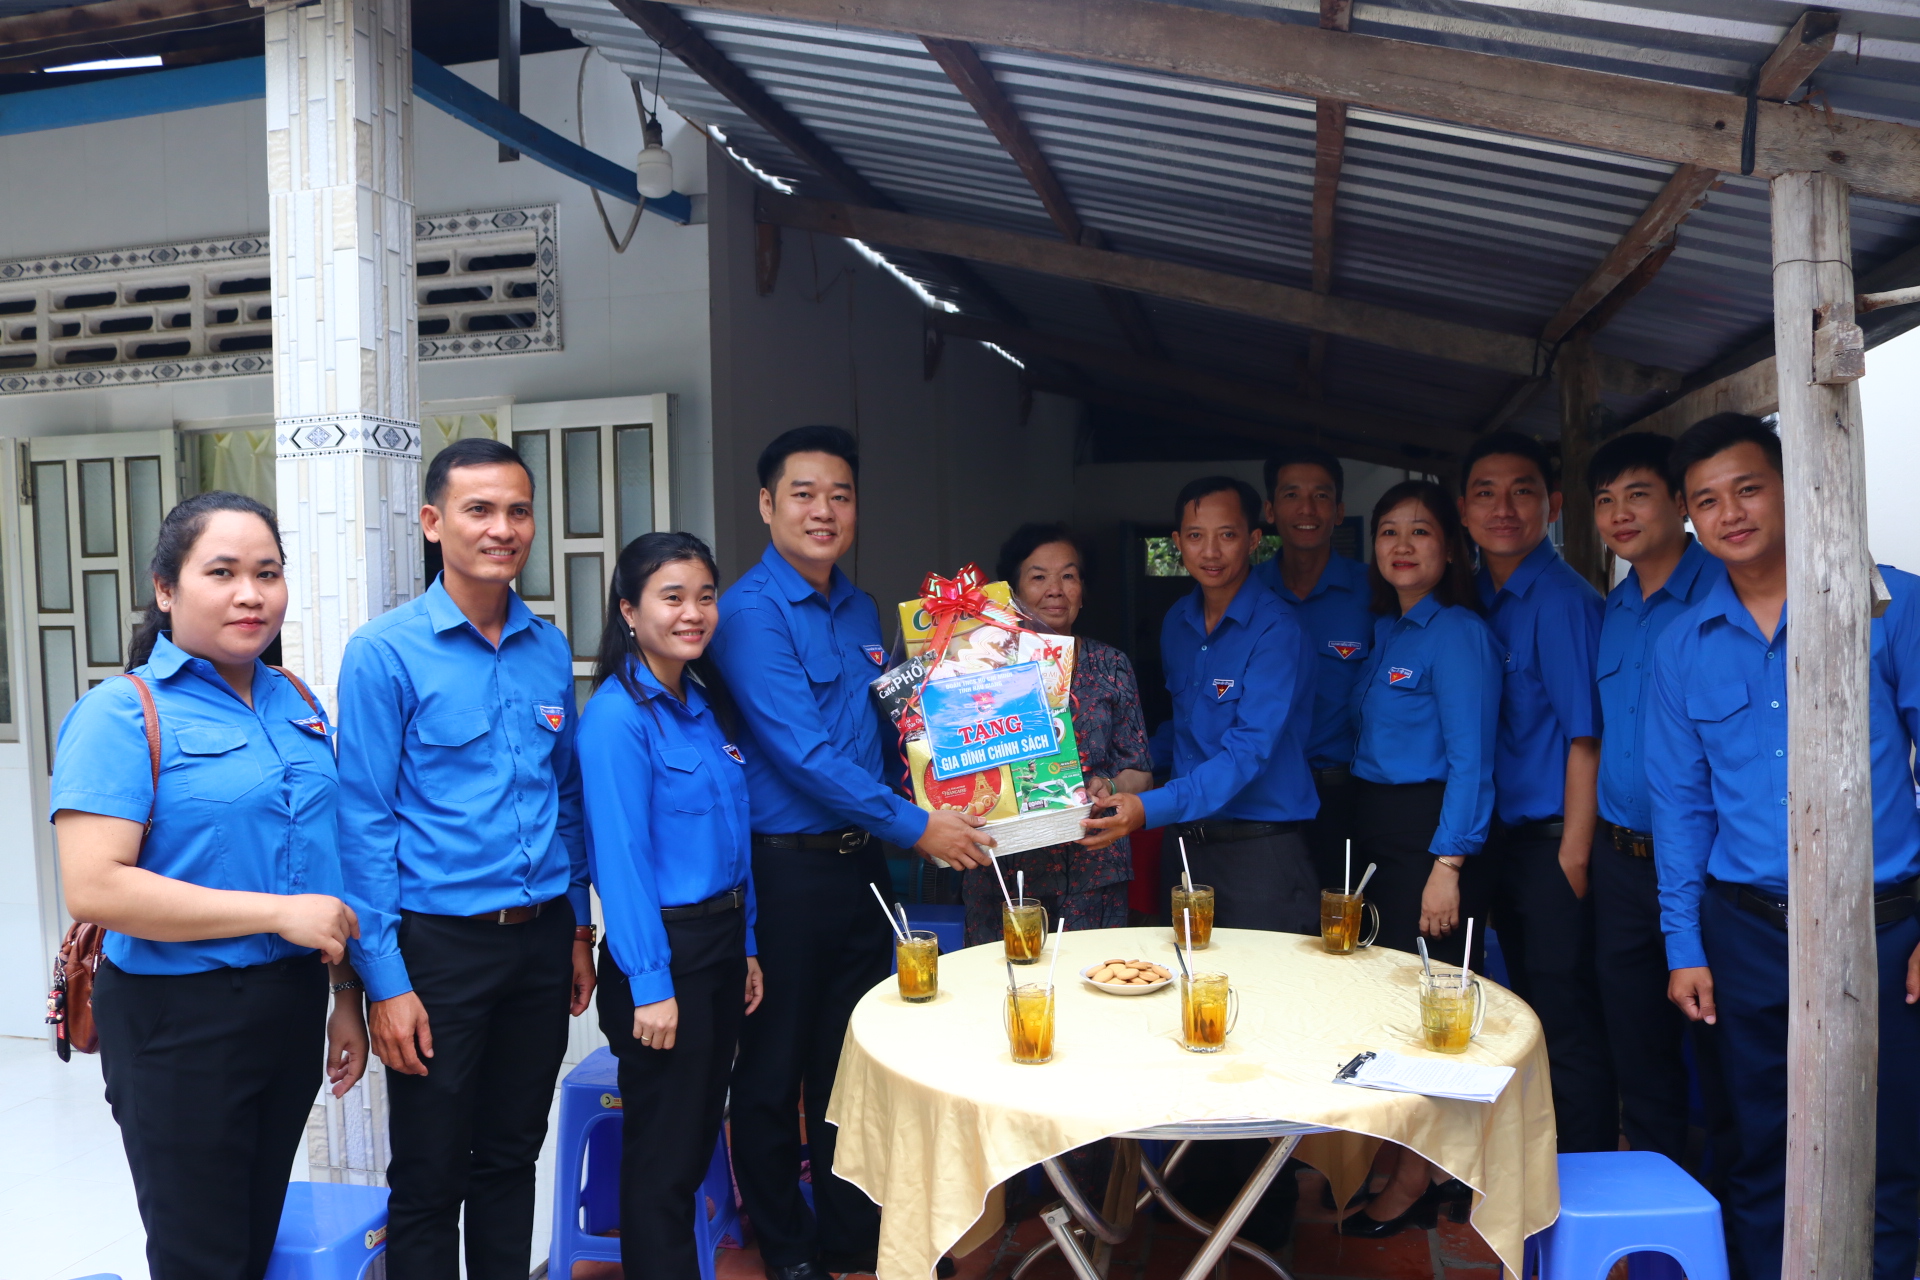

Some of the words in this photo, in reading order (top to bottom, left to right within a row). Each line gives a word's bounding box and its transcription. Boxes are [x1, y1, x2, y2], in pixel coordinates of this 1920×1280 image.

[879, 683, 896, 699] Café
[892, 660, 923, 690] PHỐ
[957, 715, 1022, 745] TẶNG
[941, 755, 960, 771] GIA
[960, 749, 987, 767] ĐÌNH
[987, 741, 1020, 760] CHÍNH
[1021, 734, 1049, 753] SÁCH
